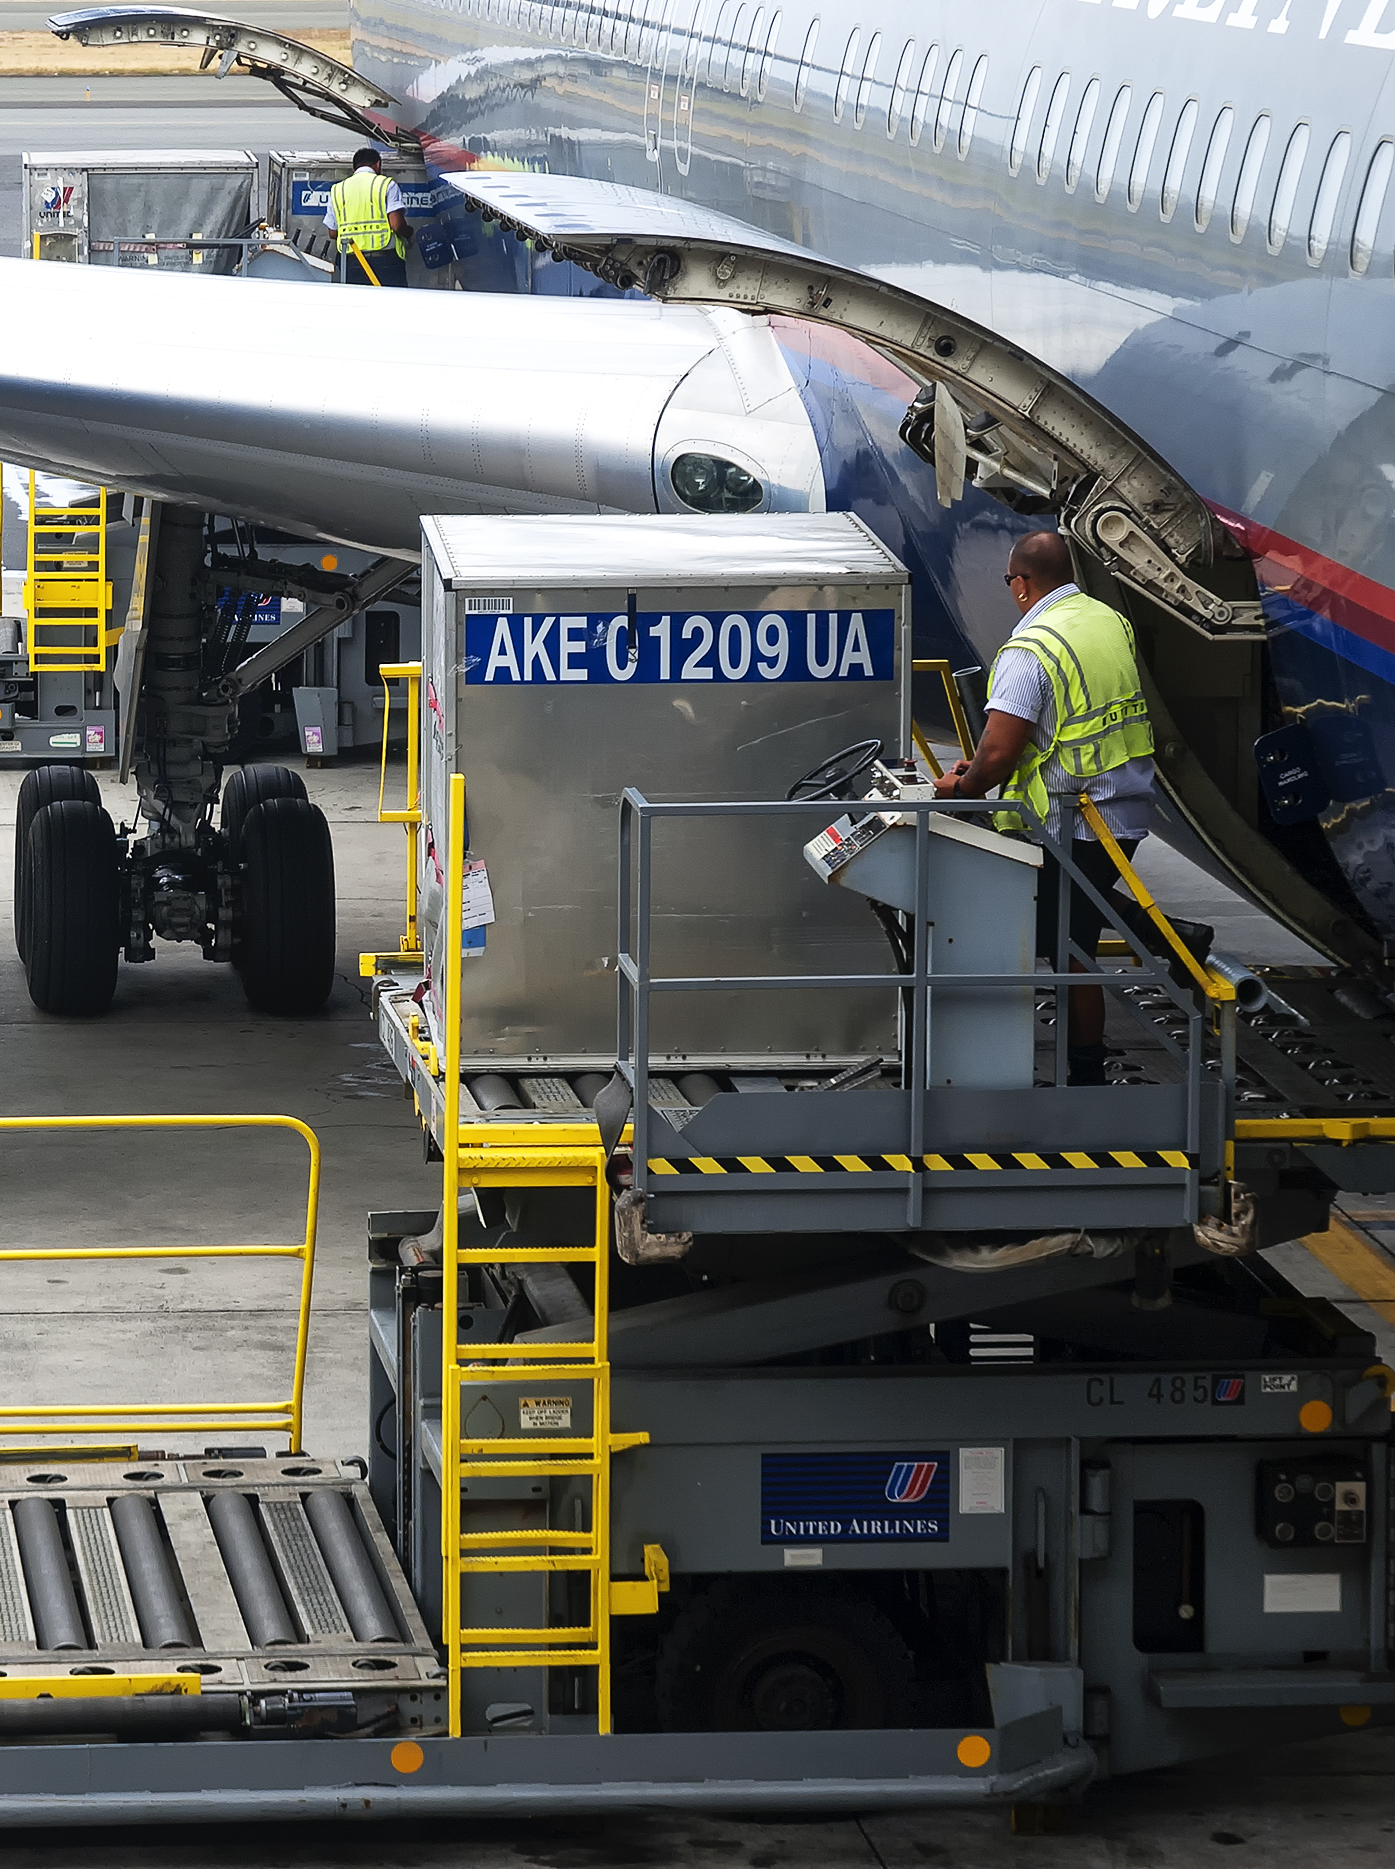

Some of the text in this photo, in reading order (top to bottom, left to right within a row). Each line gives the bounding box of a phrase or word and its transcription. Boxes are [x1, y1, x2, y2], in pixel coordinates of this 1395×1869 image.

[484, 612, 875, 682] AKE 01209 UA
[534, 1399, 571, 1408] WARNING
[1086, 1376, 1209, 1407] CL 485
[769, 1518, 939, 1536] UNITED AIRLINES
